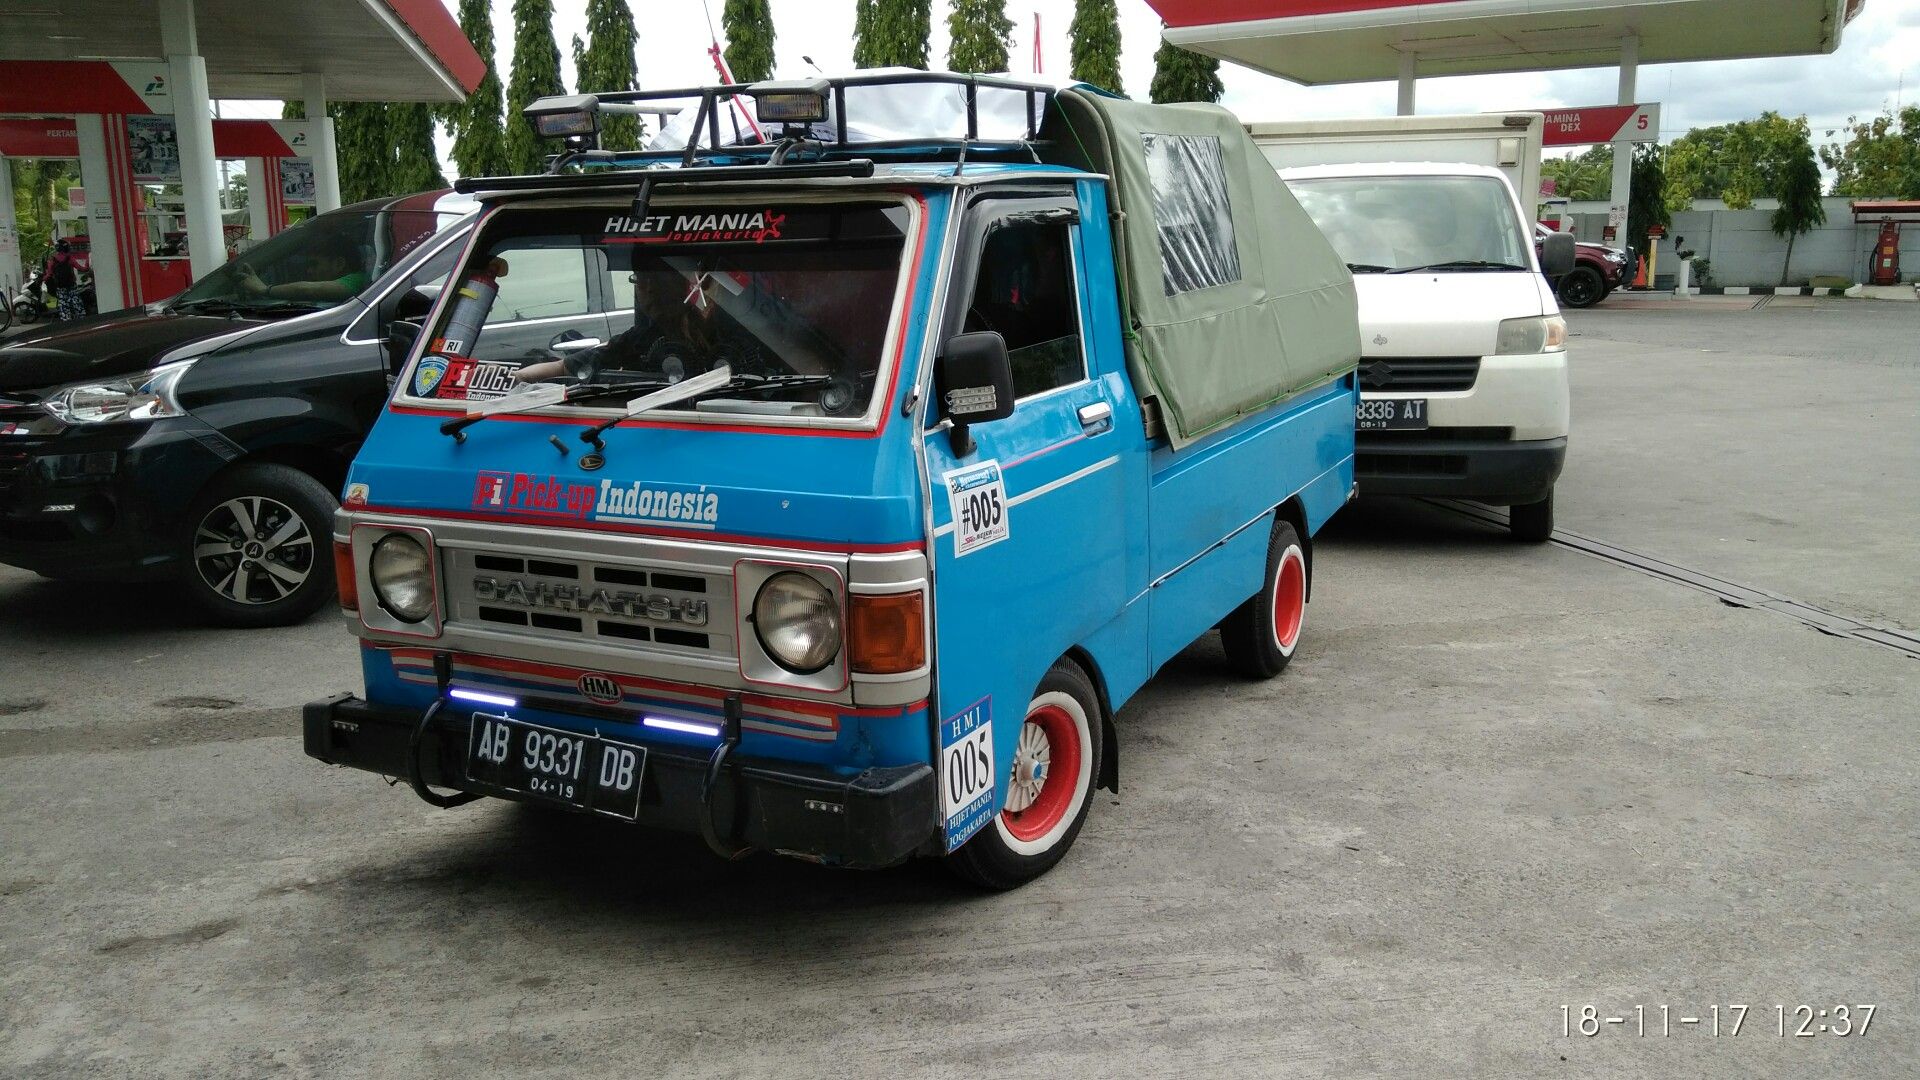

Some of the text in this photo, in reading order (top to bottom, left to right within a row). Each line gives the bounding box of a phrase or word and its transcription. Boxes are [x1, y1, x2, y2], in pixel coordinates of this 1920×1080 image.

[1560, 122, 1580, 132] DEX
[1637, 114, 1649, 130] 5
[674, 212, 765, 231] MANIA
[446, 341, 458, 351] RI
[442, 362, 471, 387] Pi
[1356, 400, 1425, 419] 8336 AT
[508, 472, 596, 519] Pick-up
[597, 479, 719, 522] Indonesia
[962, 487, 1001, 536] #005
[473, 574, 709, 628] DAIHATSU
[582, 676, 619, 697] HMJ
[478, 720, 637, 791] AB 9331 DB
[950, 730, 990, 805] 005
[949, 790, 993, 830] HIJET MANIA
[948, 808, 992, 850] JOGJAKARTA
